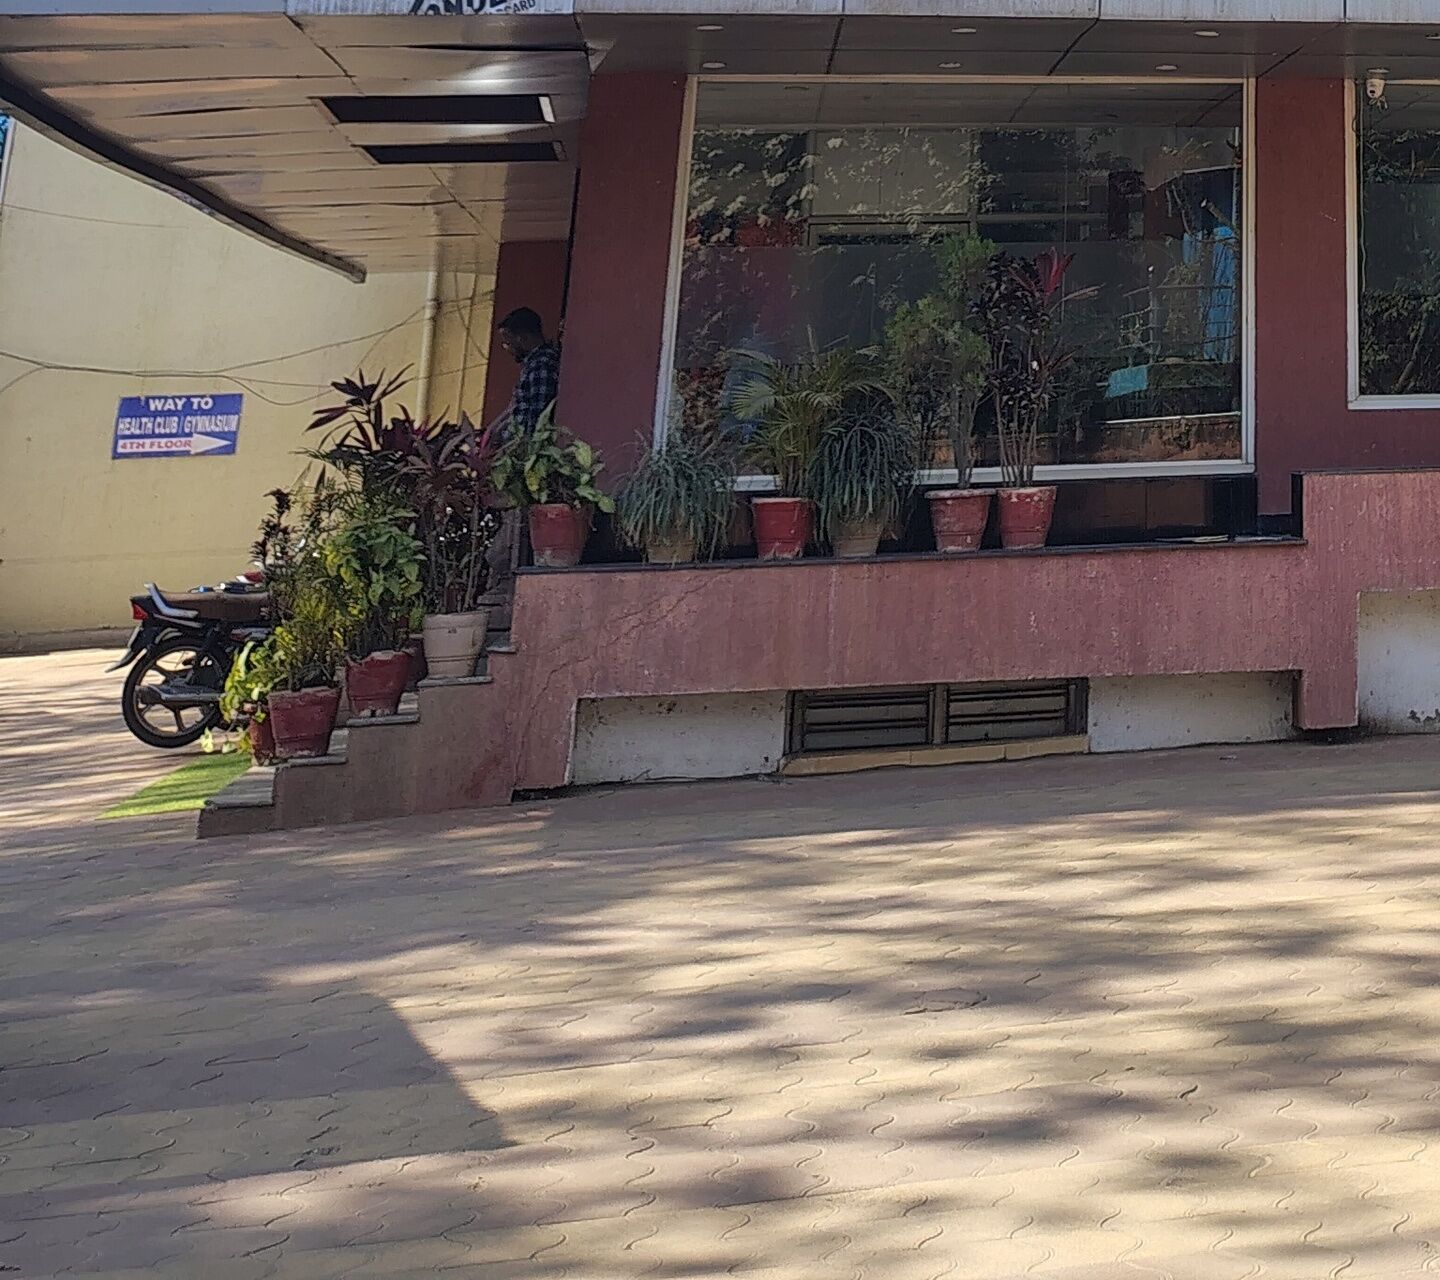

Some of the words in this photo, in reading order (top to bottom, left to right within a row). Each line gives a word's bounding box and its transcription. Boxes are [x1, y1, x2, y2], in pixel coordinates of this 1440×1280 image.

[149, 398, 185, 411] WAY
[192, 397, 213, 410] TO
[118, 417, 153, 435] HEALTH
[154, 415, 178, 434] CLUB
[184, 414, 239, 432] GYMNASIUM
[120, 440, 146, 451] 4TH
[148, 438, 193, 450] FLOOR
